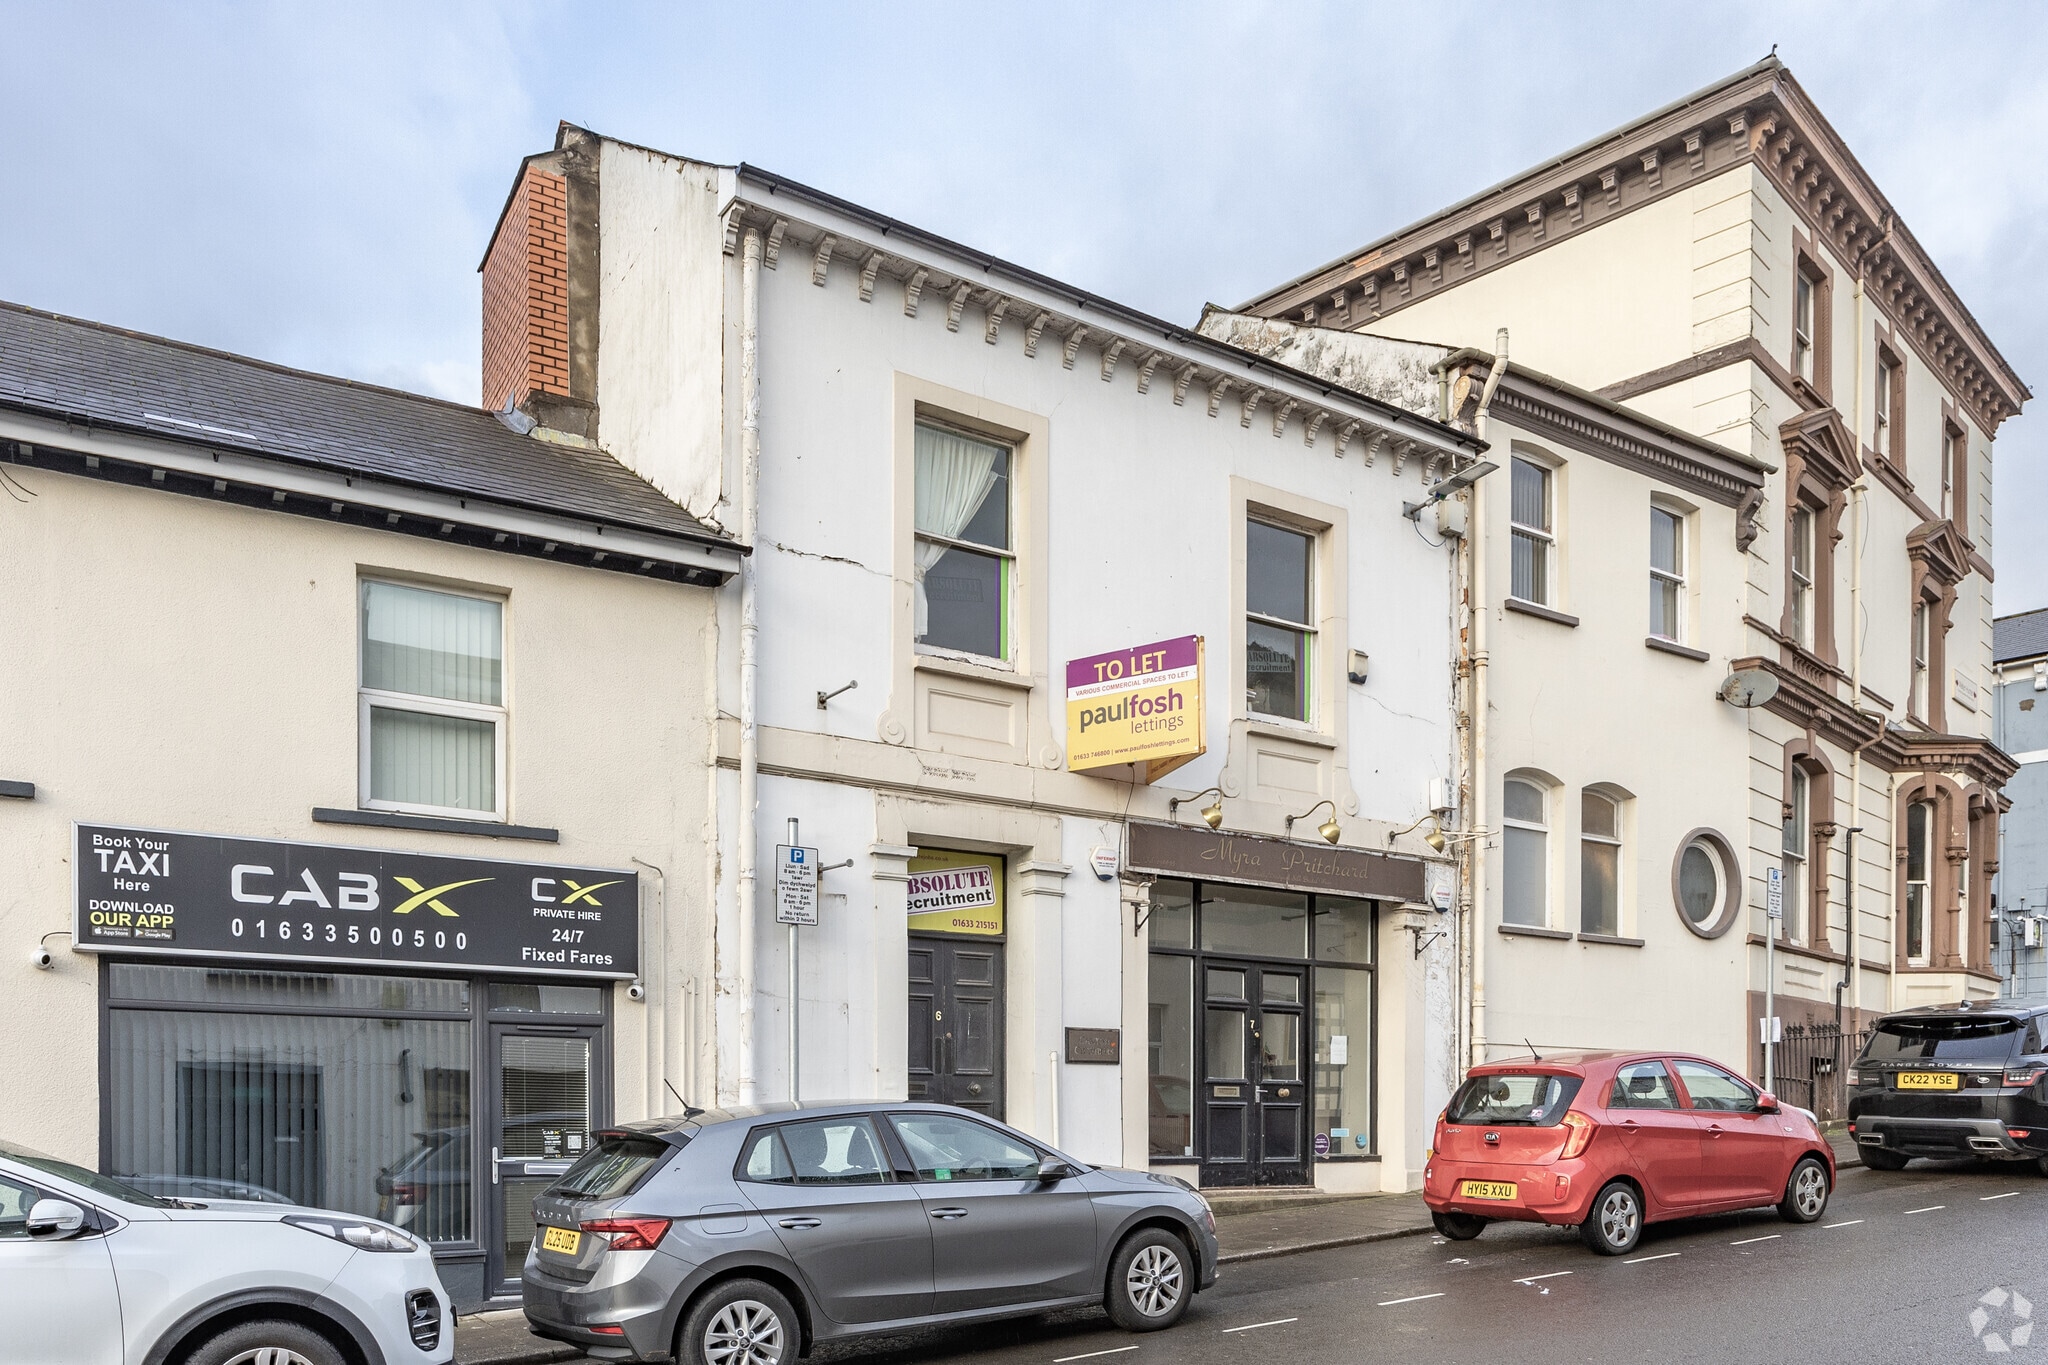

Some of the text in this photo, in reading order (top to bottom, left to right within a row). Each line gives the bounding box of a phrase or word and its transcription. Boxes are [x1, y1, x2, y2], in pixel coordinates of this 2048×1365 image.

[1093, 650, 1167, 682] TO LET
[1075, 670, 1190, 696] VARIOUS COMMERCIAL SPACES TO LET
[1080, 688, 1183, 734] paulfosh
[1131, 715, 1184, 734] lettings
[1073, 753, 1090, 761] 01633
[1091, 750, 1111, 758] 746800
[1115, 737, 1190, 754] www.paulfoshlettings.com
[92, 834, 170, 851] Book Your
[93, 848, 170, 877] TAXI
[1200, 838, 1261, 874] Myra
[1281, 849, 1370, 879] Pritchard
[113, 878, 150, 892] Here
[531, 877, 625, 906] CX
[907, 871, 990, 895] BSOLUTE
[89, 899, 175, 915] DOWNLOAD
[907, 889, 992, 910] ecruitment
[90, 911, 174, 929] OUR APP
[533, 908, 602, 921] PRIVATE HIRE
[952, 919, 998, 930] 01633 215151
[551, 928, 584, 944] 24/7
[522, 947, 613, 965] Fixed Fares
[935, 1010, 942, 1021] 6
[1250, 1019, 1255, 1029] 7
[1903, 1075, 1953, 1085] CK22 YSE
[1467, 1183, 1512, 1197] HY15 XXU
